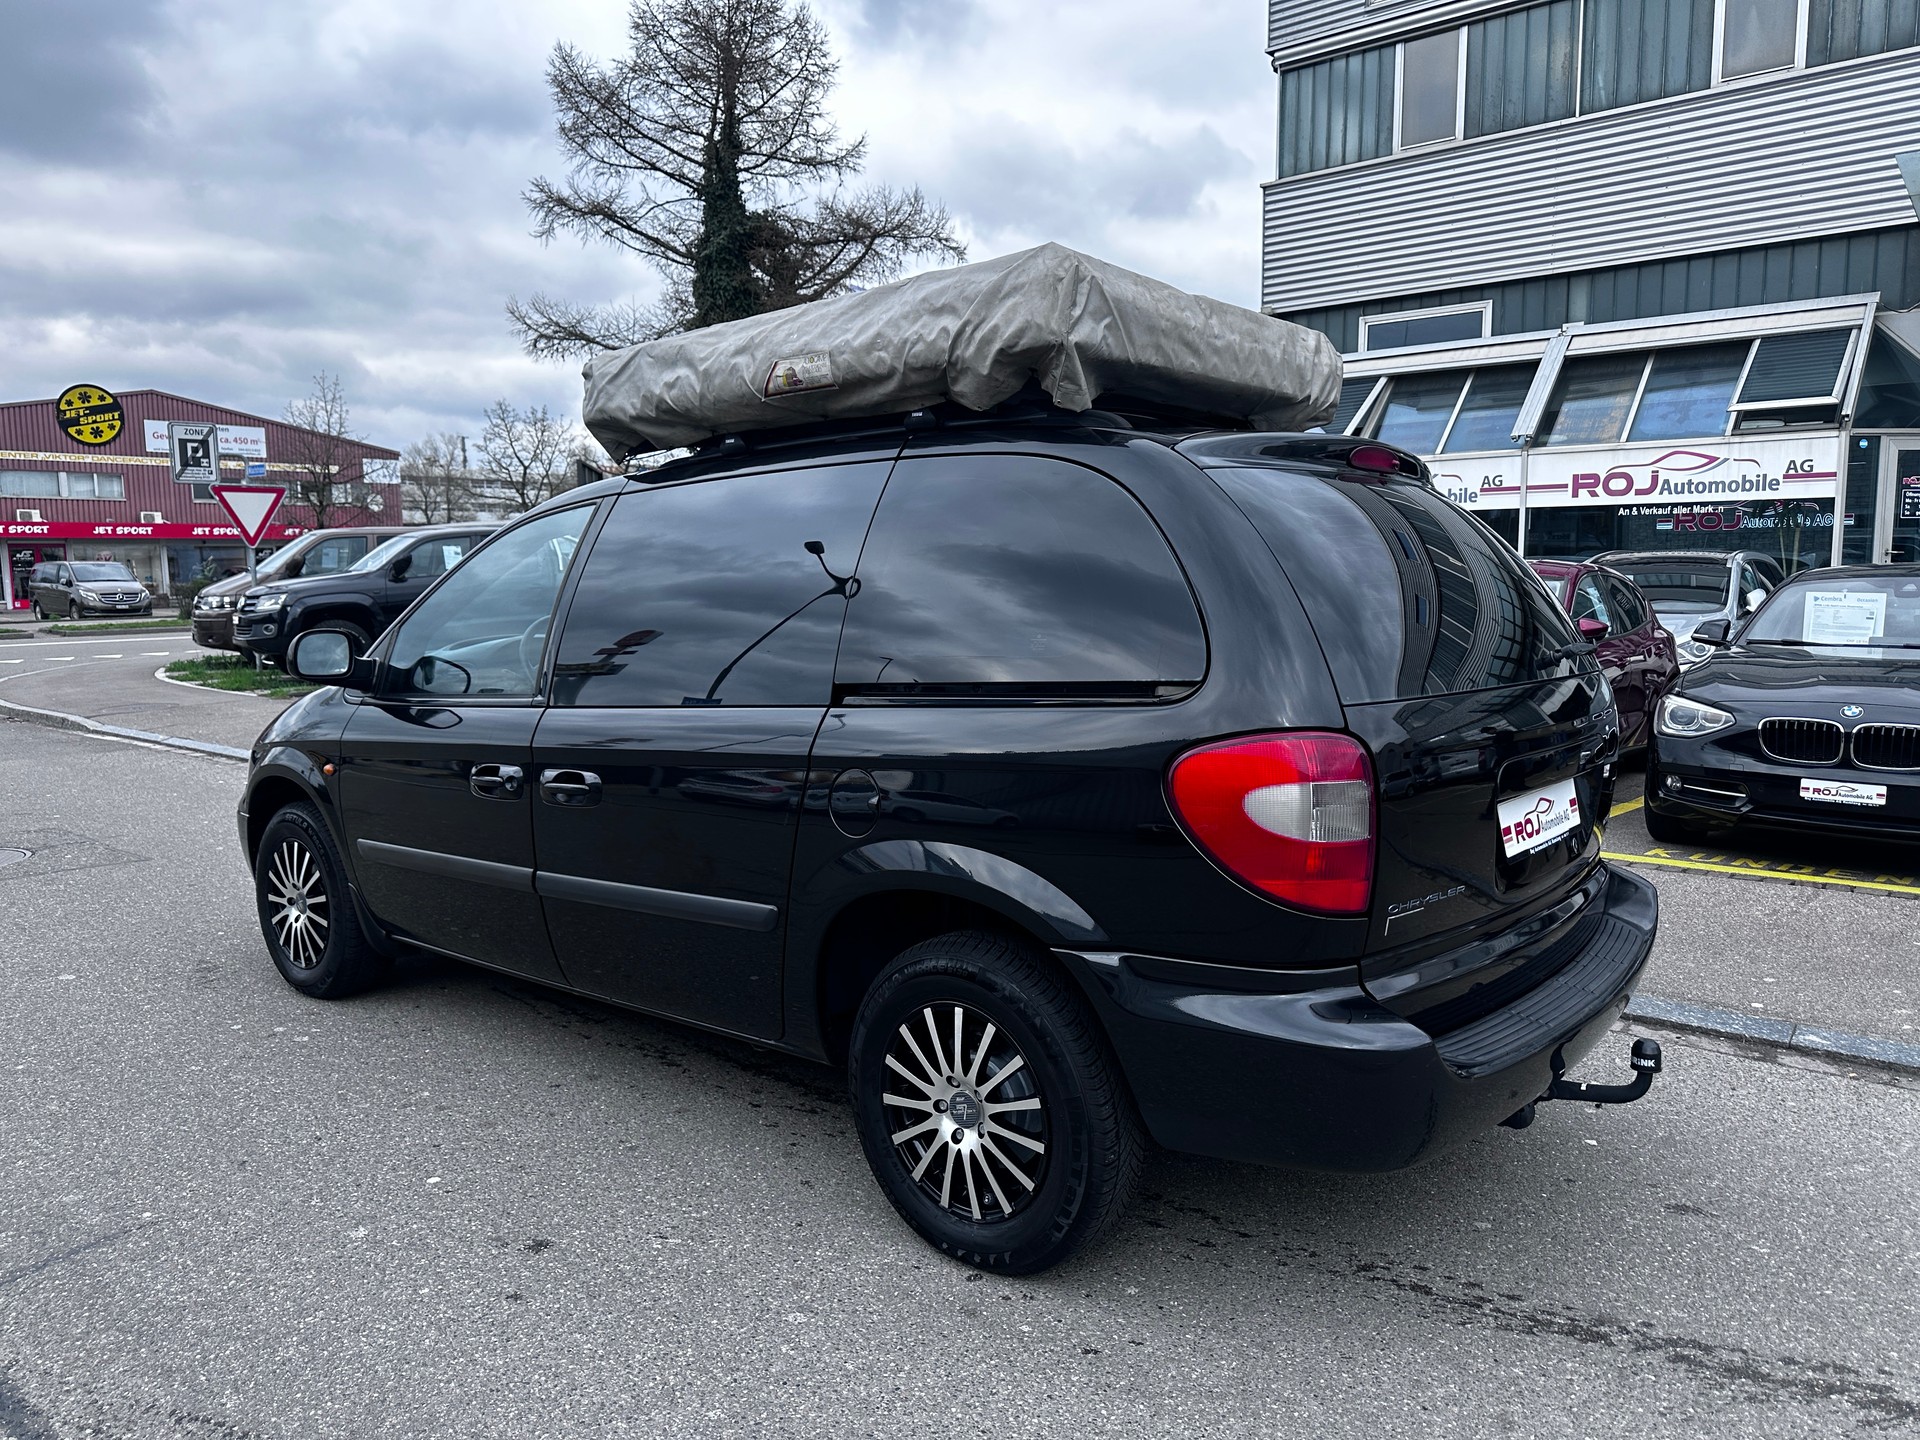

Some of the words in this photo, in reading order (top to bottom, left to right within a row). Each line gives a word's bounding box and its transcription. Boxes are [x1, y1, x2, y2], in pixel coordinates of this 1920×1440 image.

[64, 408, 90, 418] JET-
[80, 412, 120, 424] SPORT
[184, 428, 205, 436] ZONE
[232, 436, 249, 445] 450
[0, 451, 39, 459] ENTER
[91, 456, 170, 465] DANCEFACTOR
[1571, 469, 1660, 499] ROJ
[1658, 473, 1782, 496] Automobile
[1785, 458, 1815, 474] AG
[1447, 487, 1479, 504] bile
[1480, 474, 1504, 488] AG
[1617, 507, 1630, 516] An
[1631, 506, 1638, 515] &
[1639, 505, 1672, 516] Verkauf
[1672, 505, 1691, 514] aller
[1692, 504, 1724, 514] Markn
[1673, 510, 1743, 532] ROJ
[1812, 512, 1834, 527] AG
[8, 525, 50, 534] SPORT
[93, 526, 113, 535] JET
[116, 526, 154, 535] SPORT
[191, 527, 211, 536] JET
[283, 527, 300, 536] JET
[1812, 787, 1839, 797] ROJ
[1838, 790, 1865, 800] Automobile
[1513, 813, 1541, 844] ROJ
[1387, 885, 1466, 914] CHRYSLER
